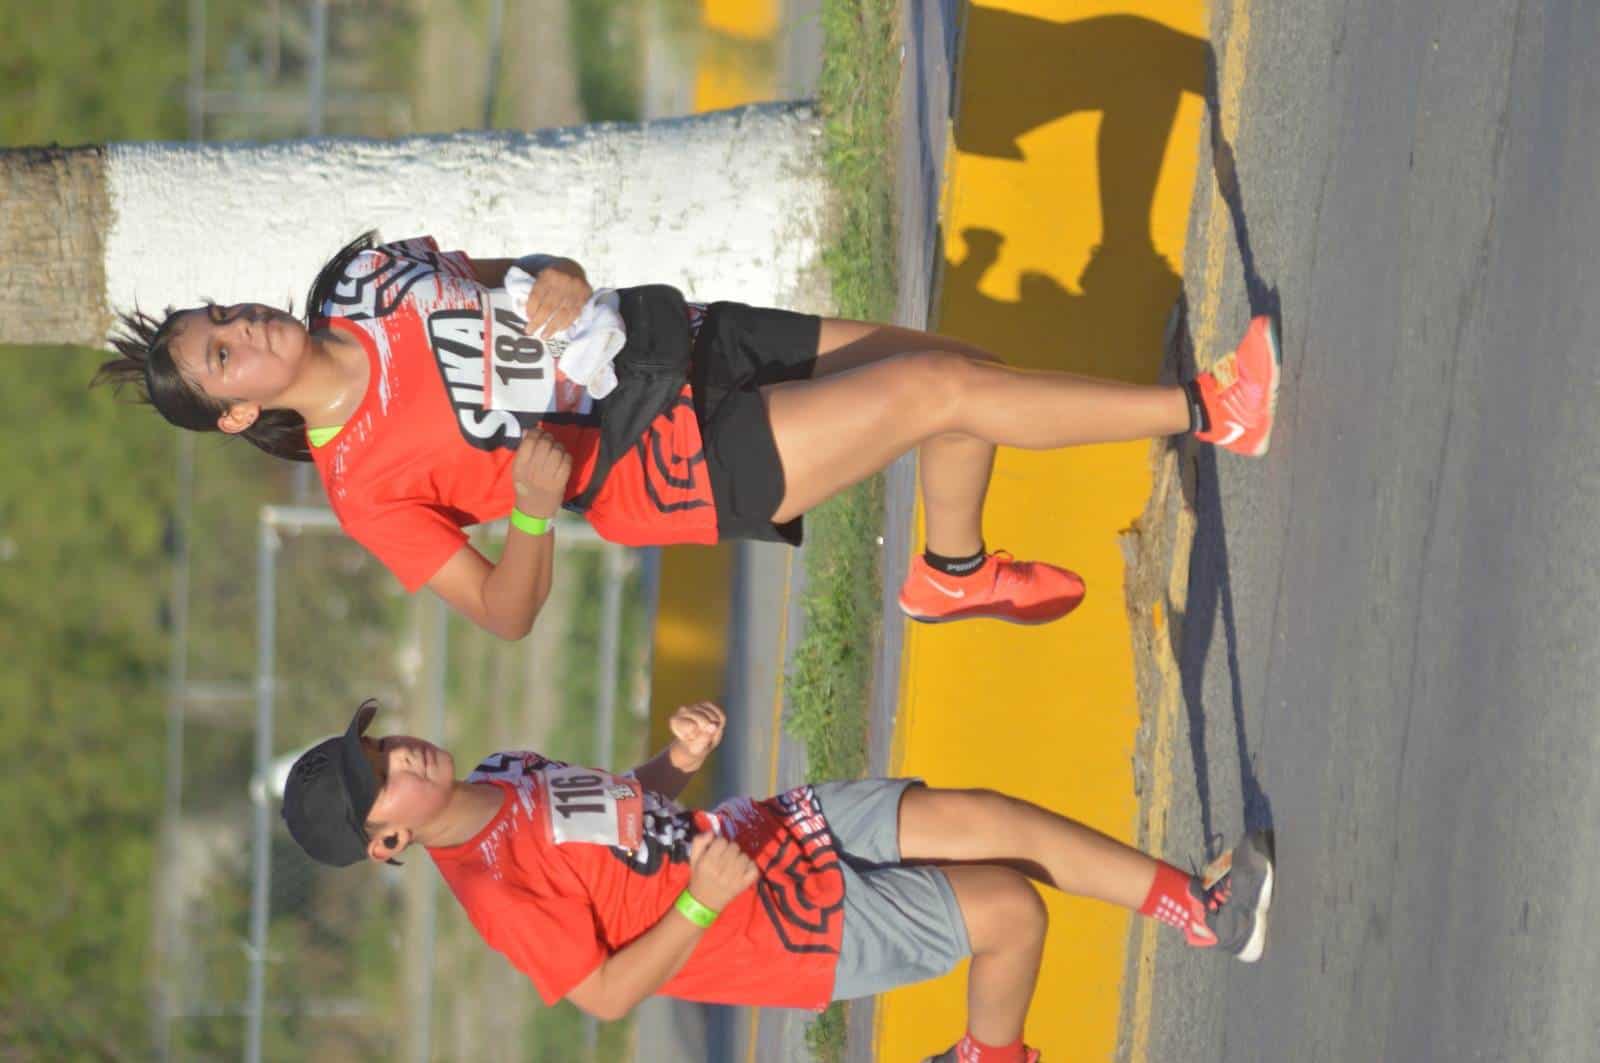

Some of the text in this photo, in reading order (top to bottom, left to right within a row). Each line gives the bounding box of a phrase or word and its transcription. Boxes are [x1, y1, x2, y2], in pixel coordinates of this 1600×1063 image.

[431, 317, 521, 438] SIKA
[494, 307, 544, 385] 184
[550, 775, 606, 819] 116
